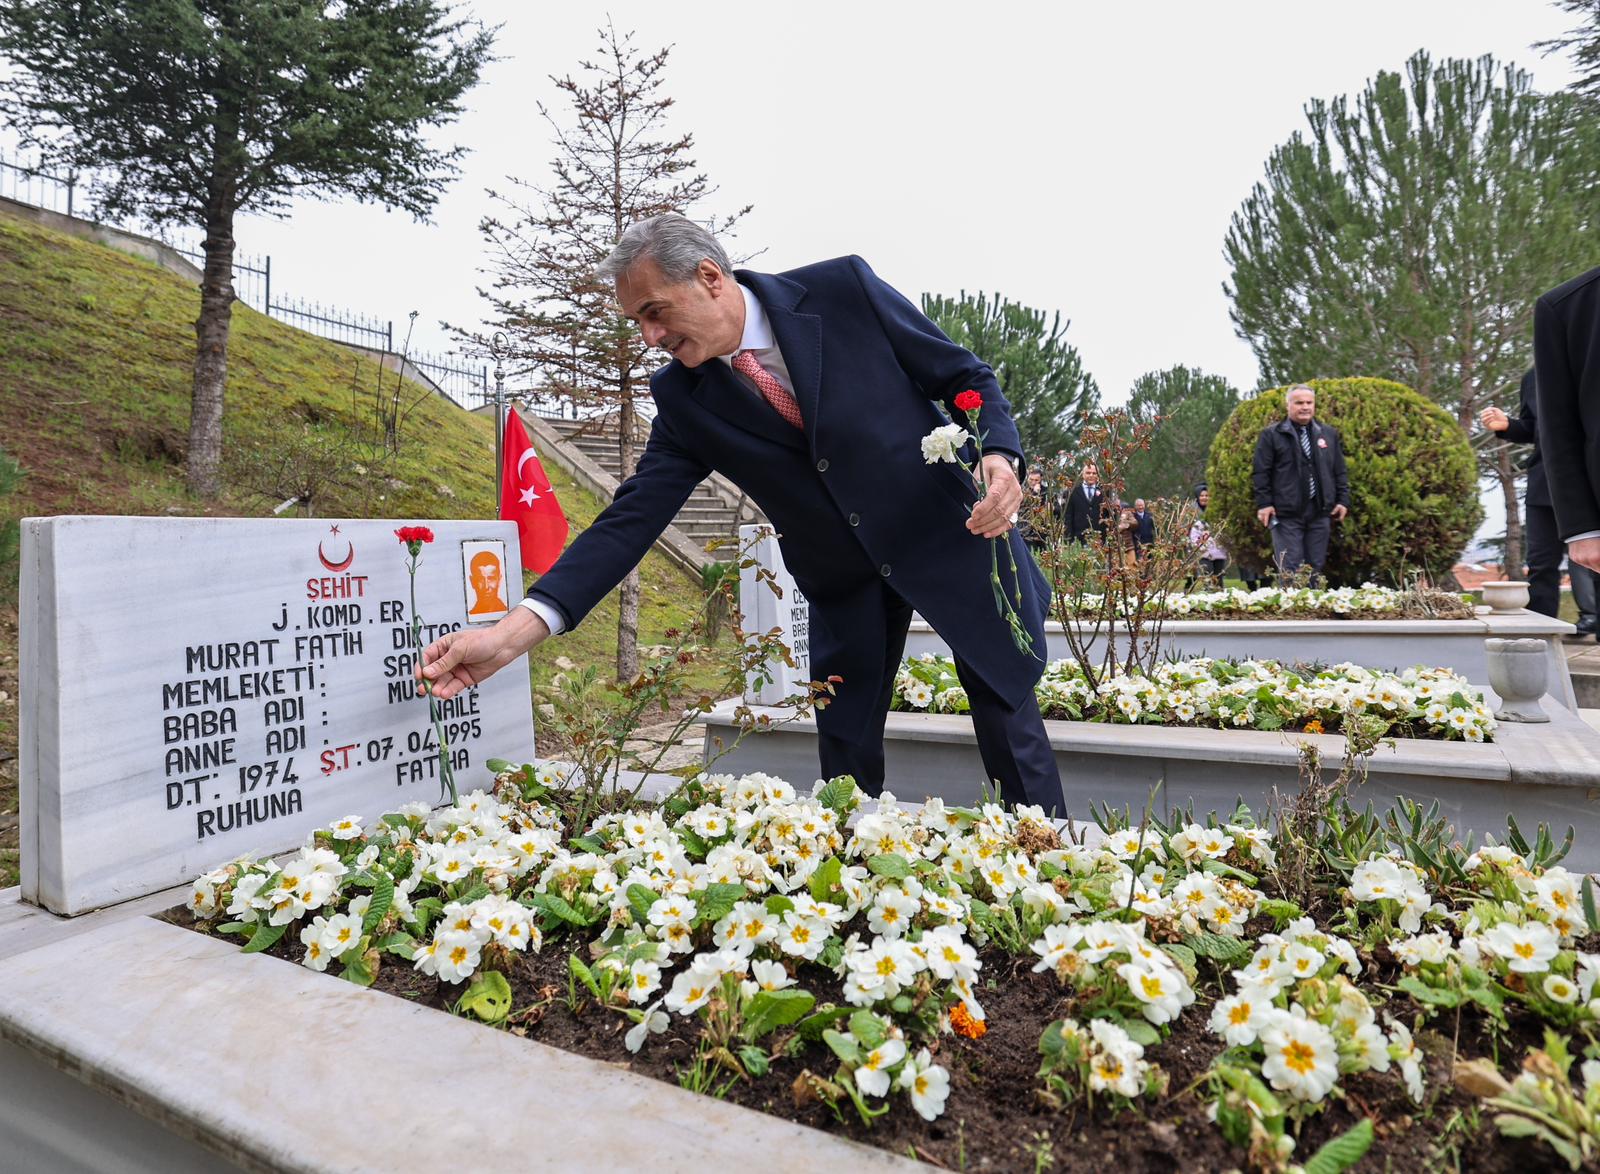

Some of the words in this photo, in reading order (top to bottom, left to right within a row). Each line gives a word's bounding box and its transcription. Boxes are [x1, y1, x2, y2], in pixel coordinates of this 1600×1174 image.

[306, 572, 368, 603] ŞEHİT
[186, 638, 280, 674] MURAT
[295, 628, 364, 662] FATİH
[163, 707, 237, 745] BABA
[165, 738, 237, 777] ANNE
[239, 757, 299, 794] 1974
[196, 788, 303, 840] RUHUNA
[396, 748, 470, 787] FATHA
